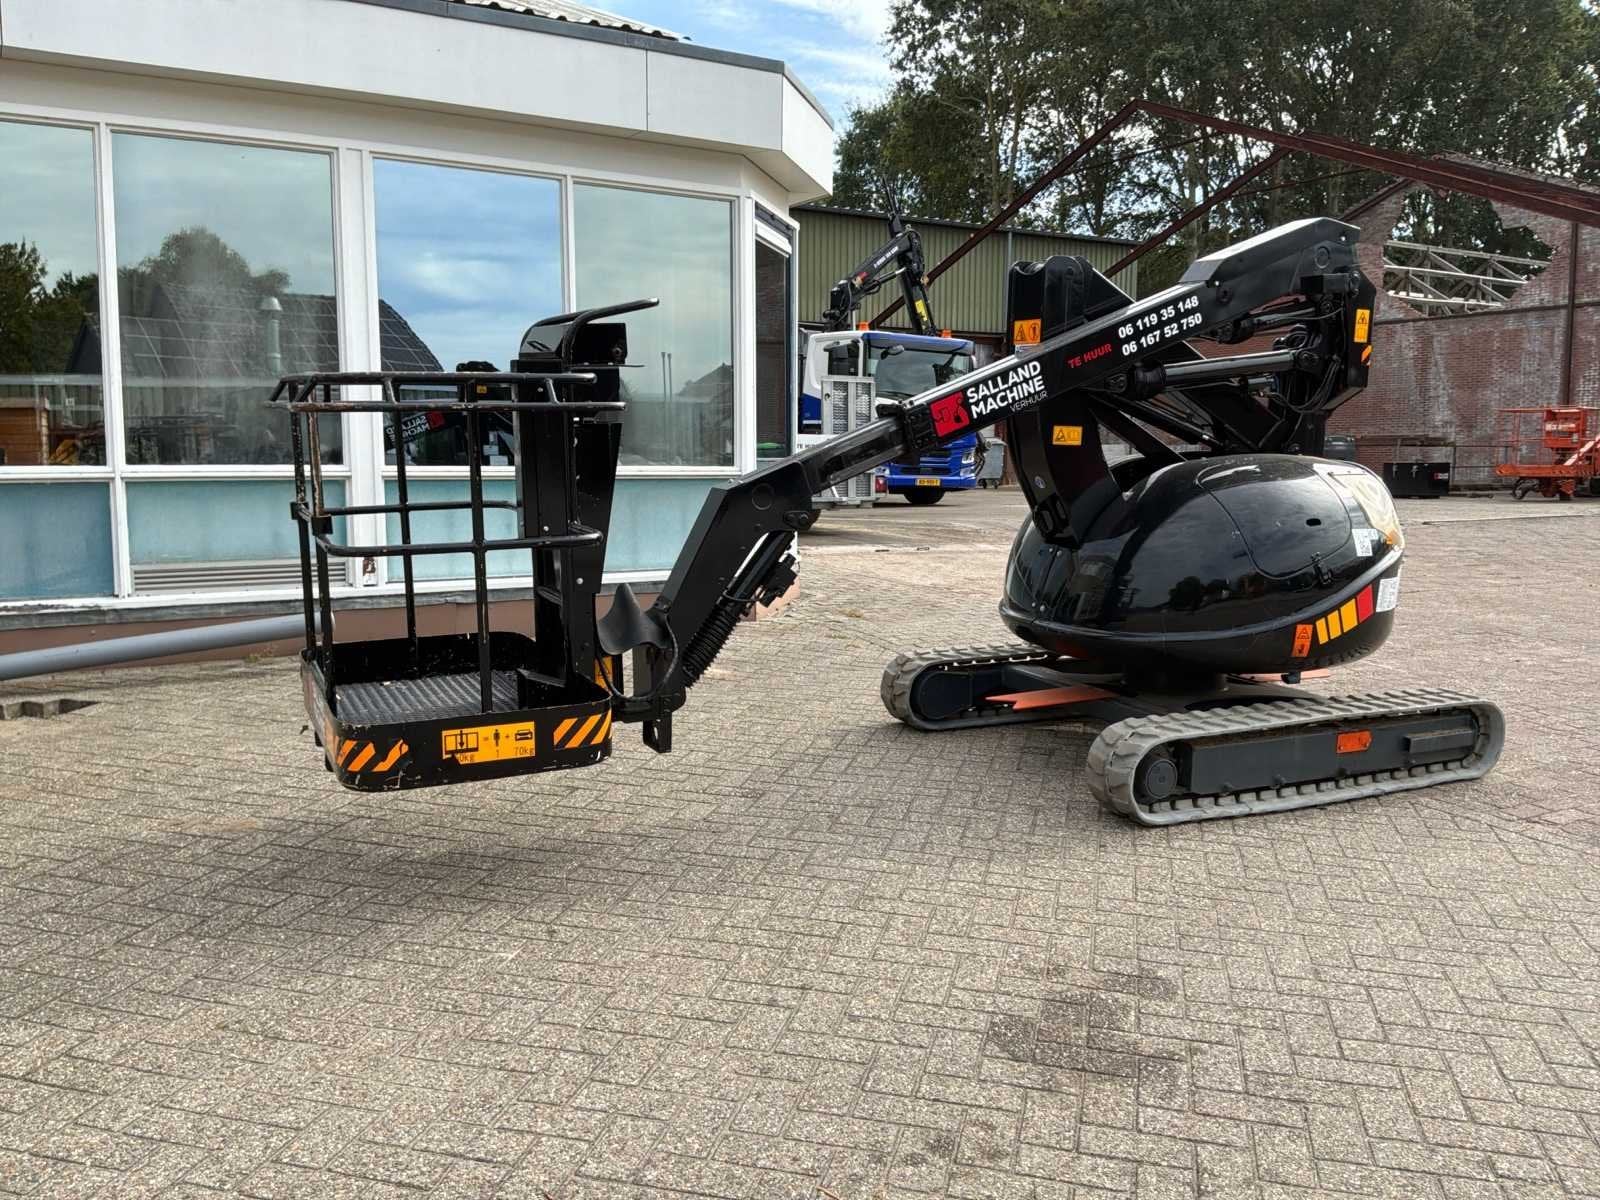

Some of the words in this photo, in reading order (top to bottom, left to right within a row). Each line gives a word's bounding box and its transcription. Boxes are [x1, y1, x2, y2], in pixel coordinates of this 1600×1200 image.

[1118, 323, 1134, 338] 06
[1136, 313, 1158, 331] 119
[1160, 305, 1175, 321] 35
[1177, 295, 1199, 312] 148
[1122, 341, 1137, 356] 06
[1140, 330, 1161, 348] 167
[1164, 322, 1179, 338] 52
[1180, 313, 1203, 330] 750
[1068, 356, 1082, 369] TE
[1083, 343, 1112, 363] HUUR
[966, 360, 1041, 403] SALLAND
[970, 375, 1045, 419] MACHINE
[1009, 390, 1049, 412] VERHUUR
